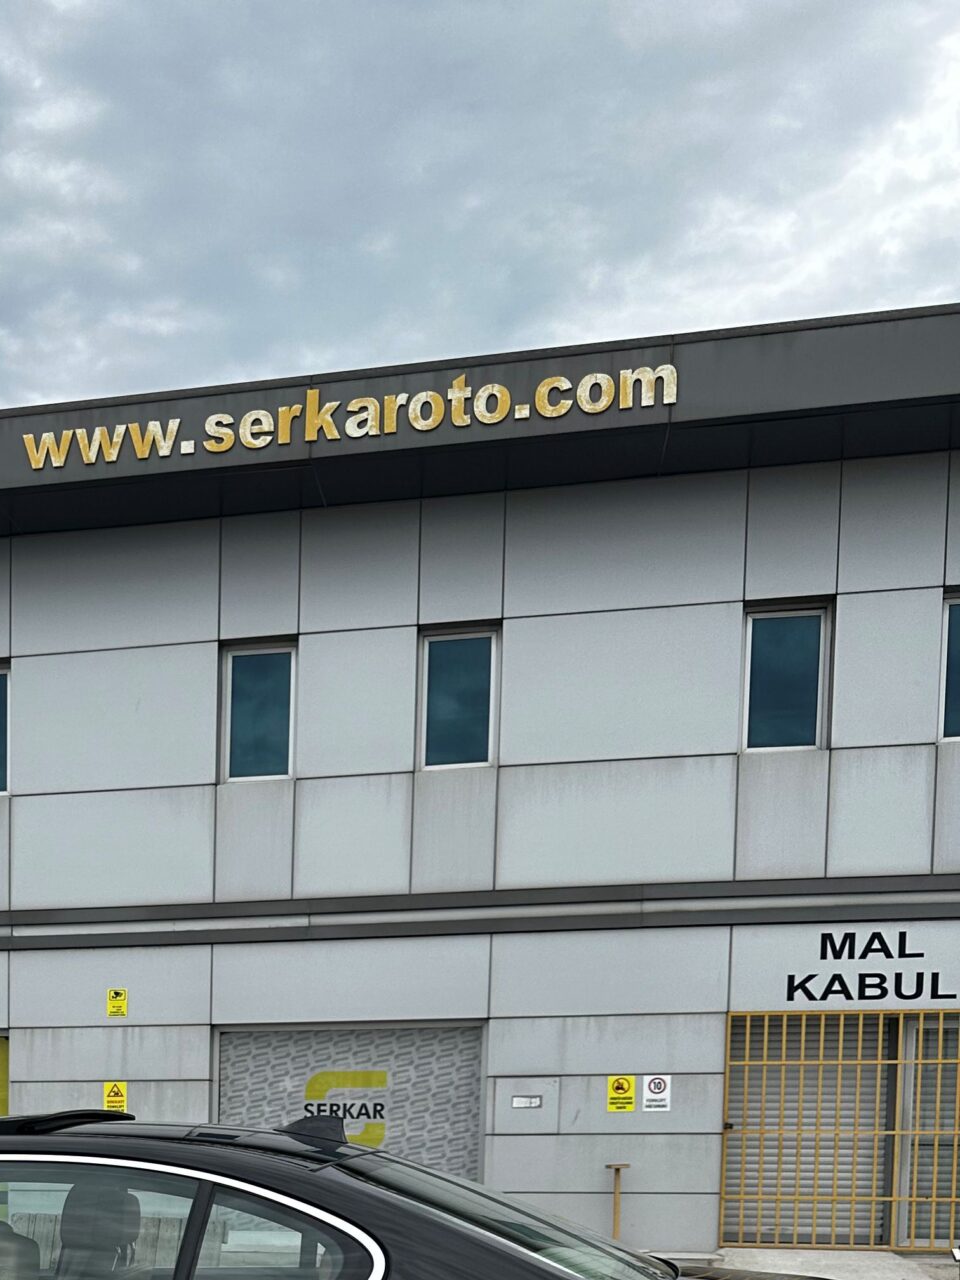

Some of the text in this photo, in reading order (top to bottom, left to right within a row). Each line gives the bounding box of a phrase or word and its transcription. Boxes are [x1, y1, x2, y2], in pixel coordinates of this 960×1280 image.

[22, 362, 679, 471] www.serkaroto.com
[819, 930, 925, 960] MAL
[786, 971, 957, 1001] KABUL
[652, 1081, 662, 1091] 10
[304, 1102, 385, 1120] SERKAR
